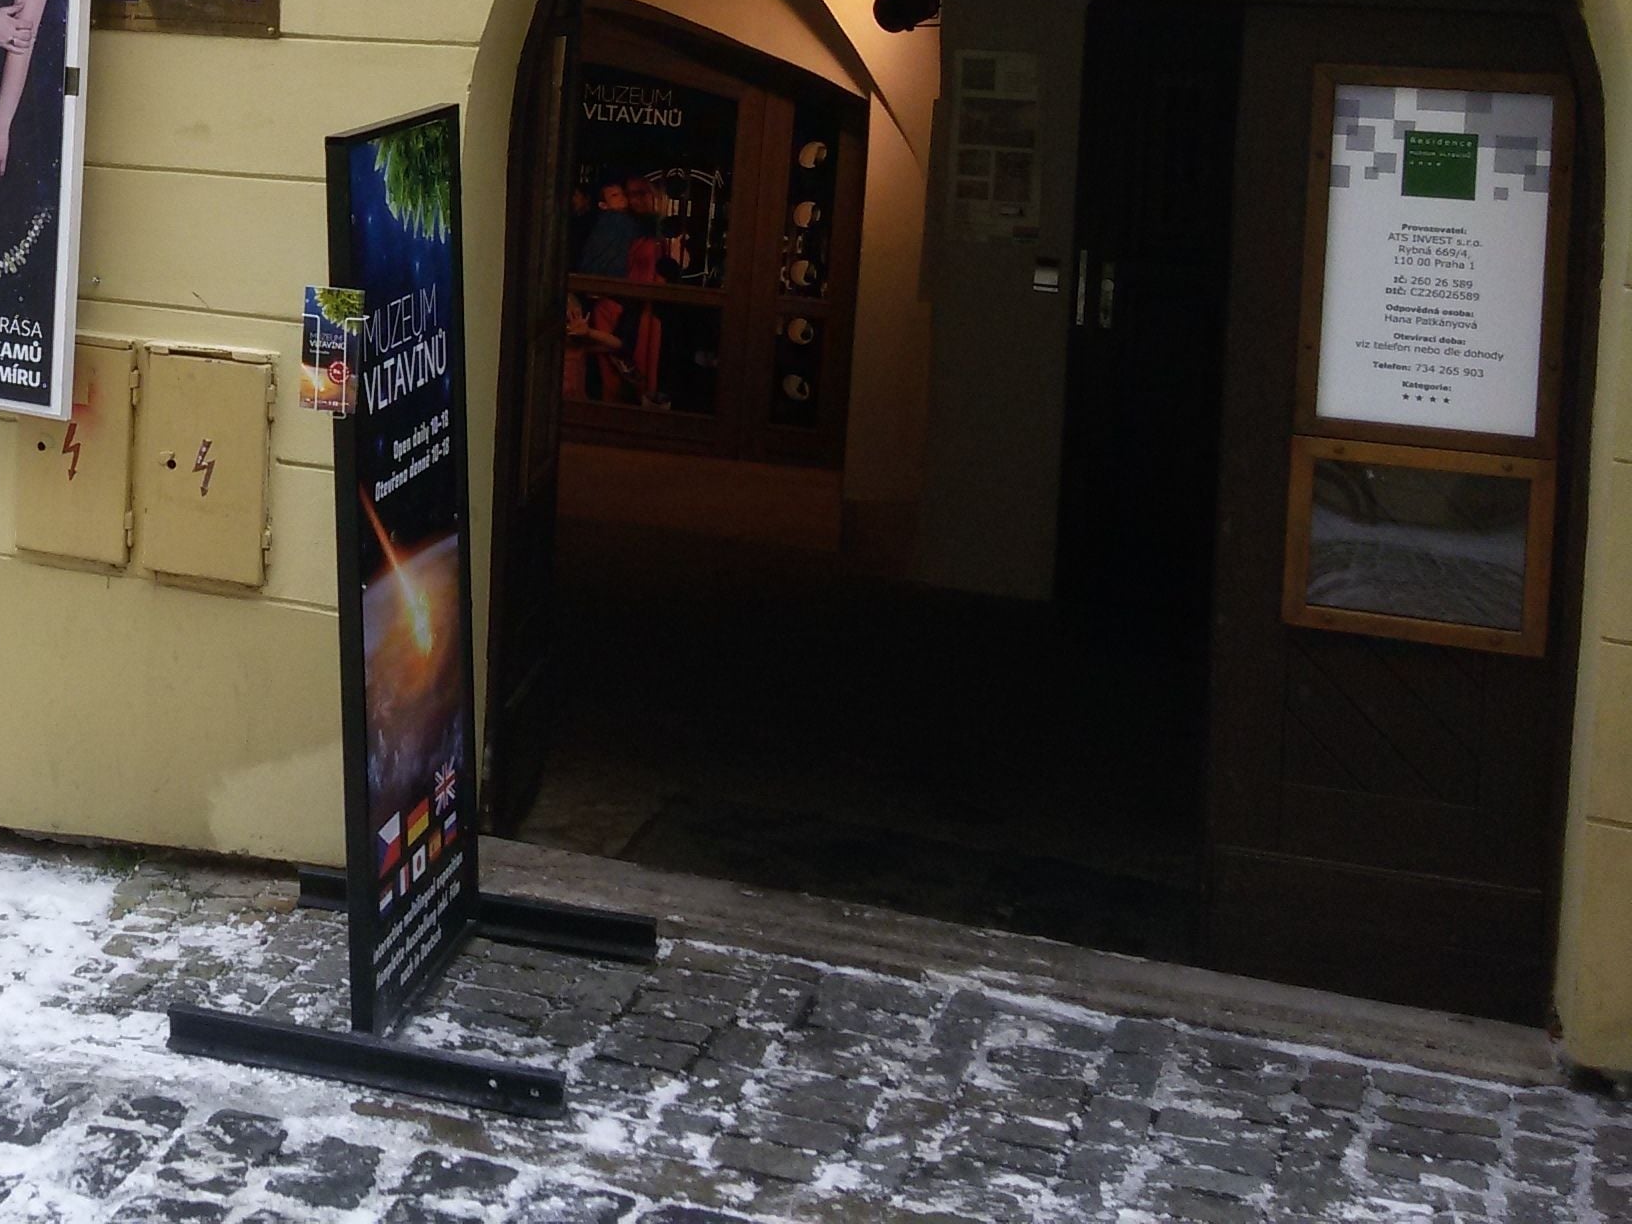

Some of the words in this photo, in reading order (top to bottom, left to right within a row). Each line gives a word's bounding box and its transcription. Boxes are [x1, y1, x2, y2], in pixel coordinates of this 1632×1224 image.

[584, 83, 672, 107] MUZEUM
[582, 103, 682, 127] VLTAVÍNŮ
[1401, 223, 1467, 235] Provozovatel:
[1388, 232, 1409, 242] ATS
[1412, 234, 1453, 245] INVEST
[1398, 245, 1432, 256] Rybná
[1394, 256, 1413, 265] 110
[1417, 257, 1431, 266] 00
[1435, 259, 1465, 270] Praha
[1469, 262, 1475, 270] 1
[1411, 276, 1431, 285] 260
[1435, 278, 1449, 287] 26
[1385, 303, 1440, 316] Odpovědná
[1442, 308, 1474, 318] osoba:
[363, 283, 437, 362] MUZEUM
[1384, 314, 1412, 324] Hana
[1439, 335, 1466, 346] doba:
[1355, 339, 1371, 349] viz
[1373, 341, 1411, 351] telefon
[1414, 345, 1440, 355] nebo
[1443, 346, 1460, 356] dle
[1463, 349, 1504, 362] dohody
[364, 328, 446, 415] VLTAVÍNŮ
[1372, 360, 1411, 371] Telefon:
[1402, 380, 1452, 392] Kategorie:
[393, 437, 412, 462] Open
[412, 421, 430, 448] daily
[375, 470, 408, 502] Otevřeno
[409, 449, 430, 479] denně
